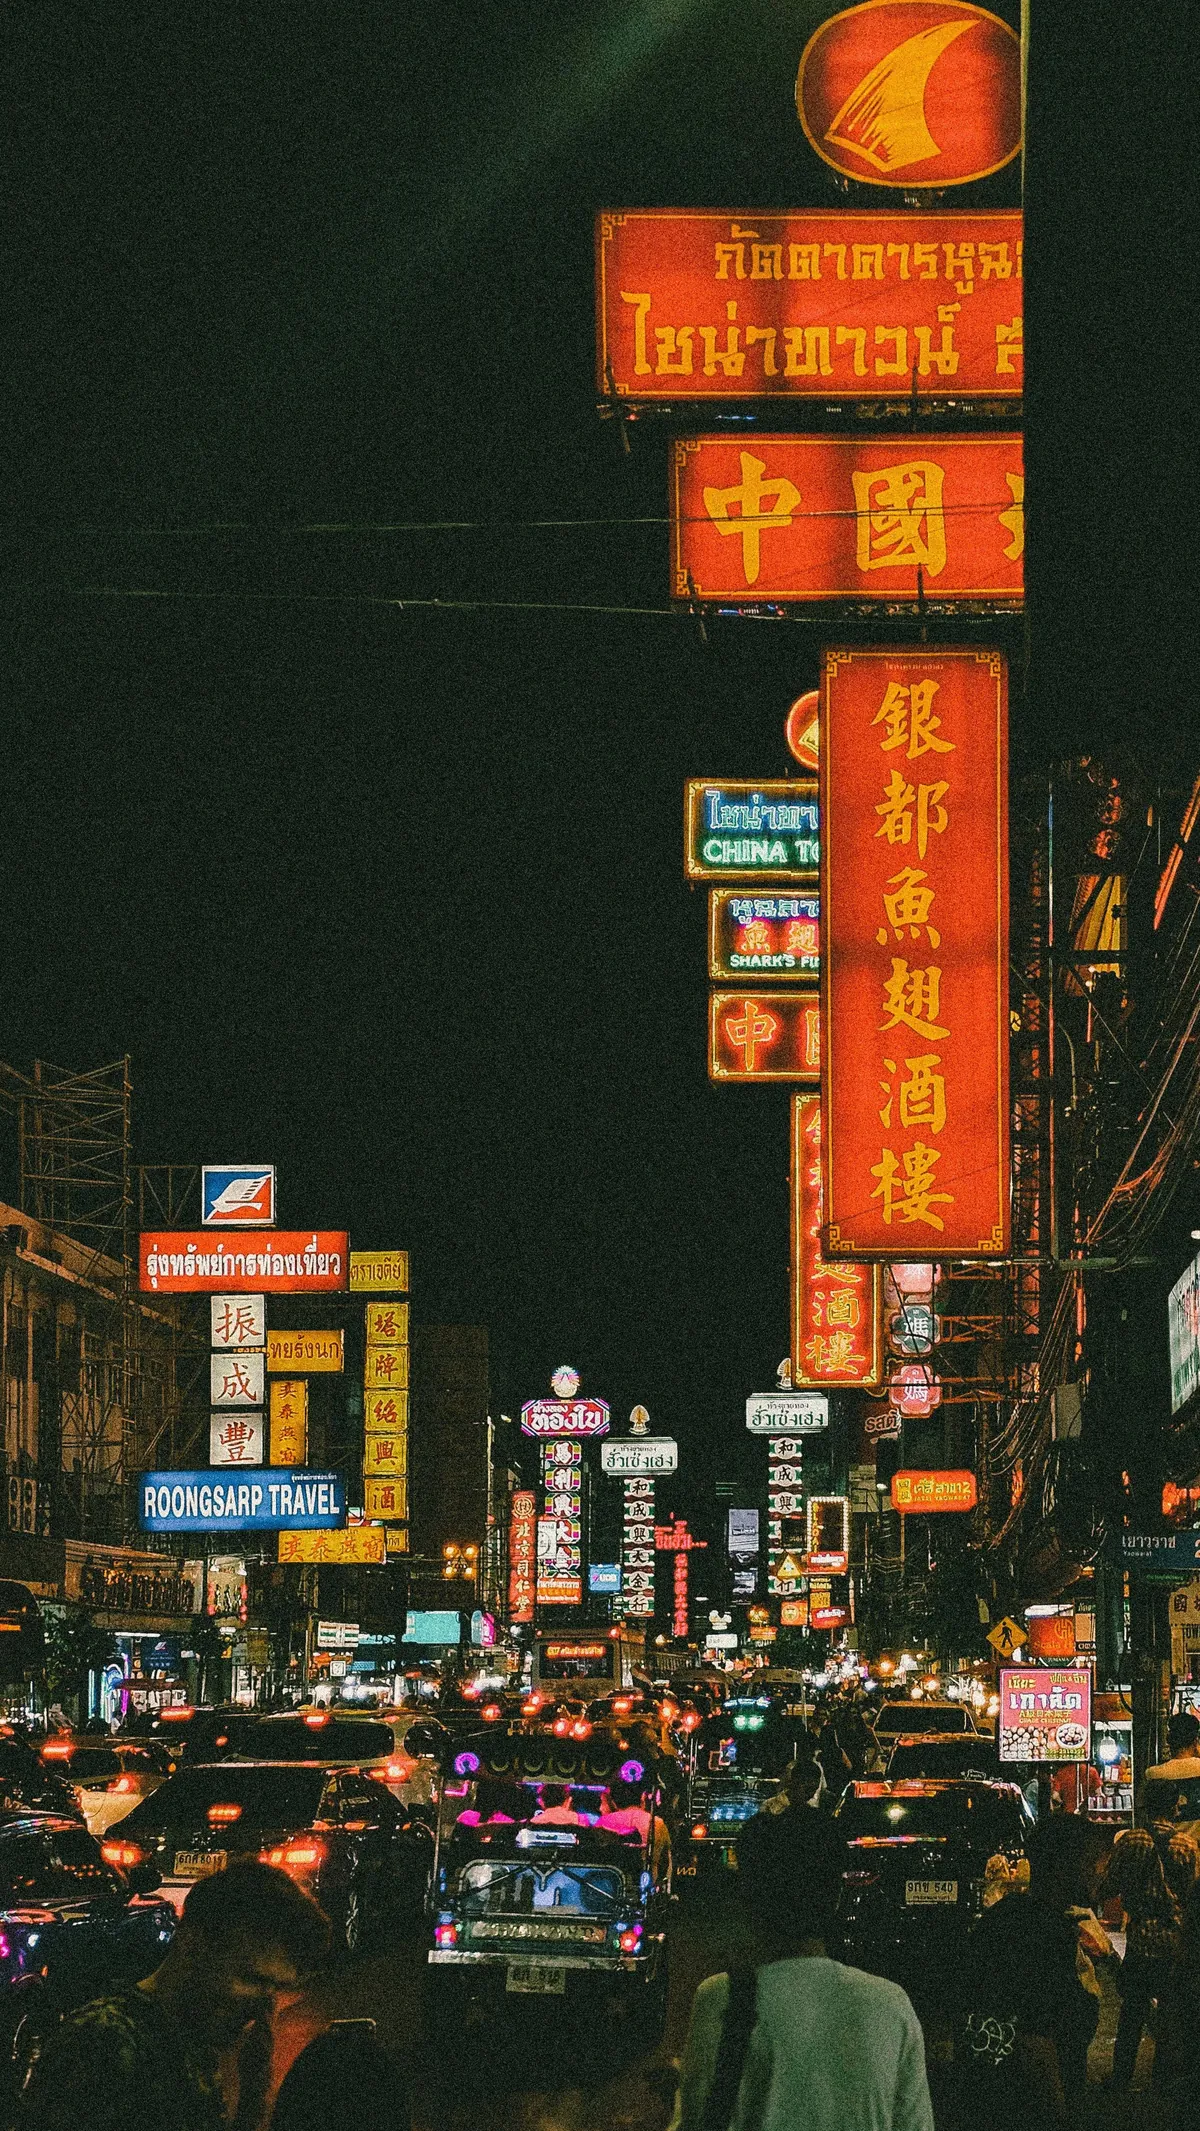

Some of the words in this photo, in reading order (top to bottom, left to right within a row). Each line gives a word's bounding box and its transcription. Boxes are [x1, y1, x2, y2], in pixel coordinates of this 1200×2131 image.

[621, 291, 960, 376] ไชน่าทาวน์
[705, 790, 819, 830] ไชน่าทา
[703, 840, 788, 863] CHINA
[730, 899, 819, 925] หูฉลา
[730, 955, 796, 968] SHARK'S
[871, 678, 957, 1232] 銀都魚翅酒樓
[147, 1235, 341, 1288] รุ่งทรัพย์การท่องเที่ยว
[267, 1334, 341, 1359] ทยรังนก
[214, 1303, 262, 1463] 振成豐
[531, 1404, 601, 1431] ทองใบ
[144, 1484, 263, 1518] ROONGSARP
[268, 1483, 340, 1515] TRAVEL
[631, 1480, 647, 1612] 和成興大金行
[1122, 1535, 1176, 1549] เยาวราช
[1009, 1685, 1082, 1710] เกาลัด
[934, 1882, 953, 1893] 540
